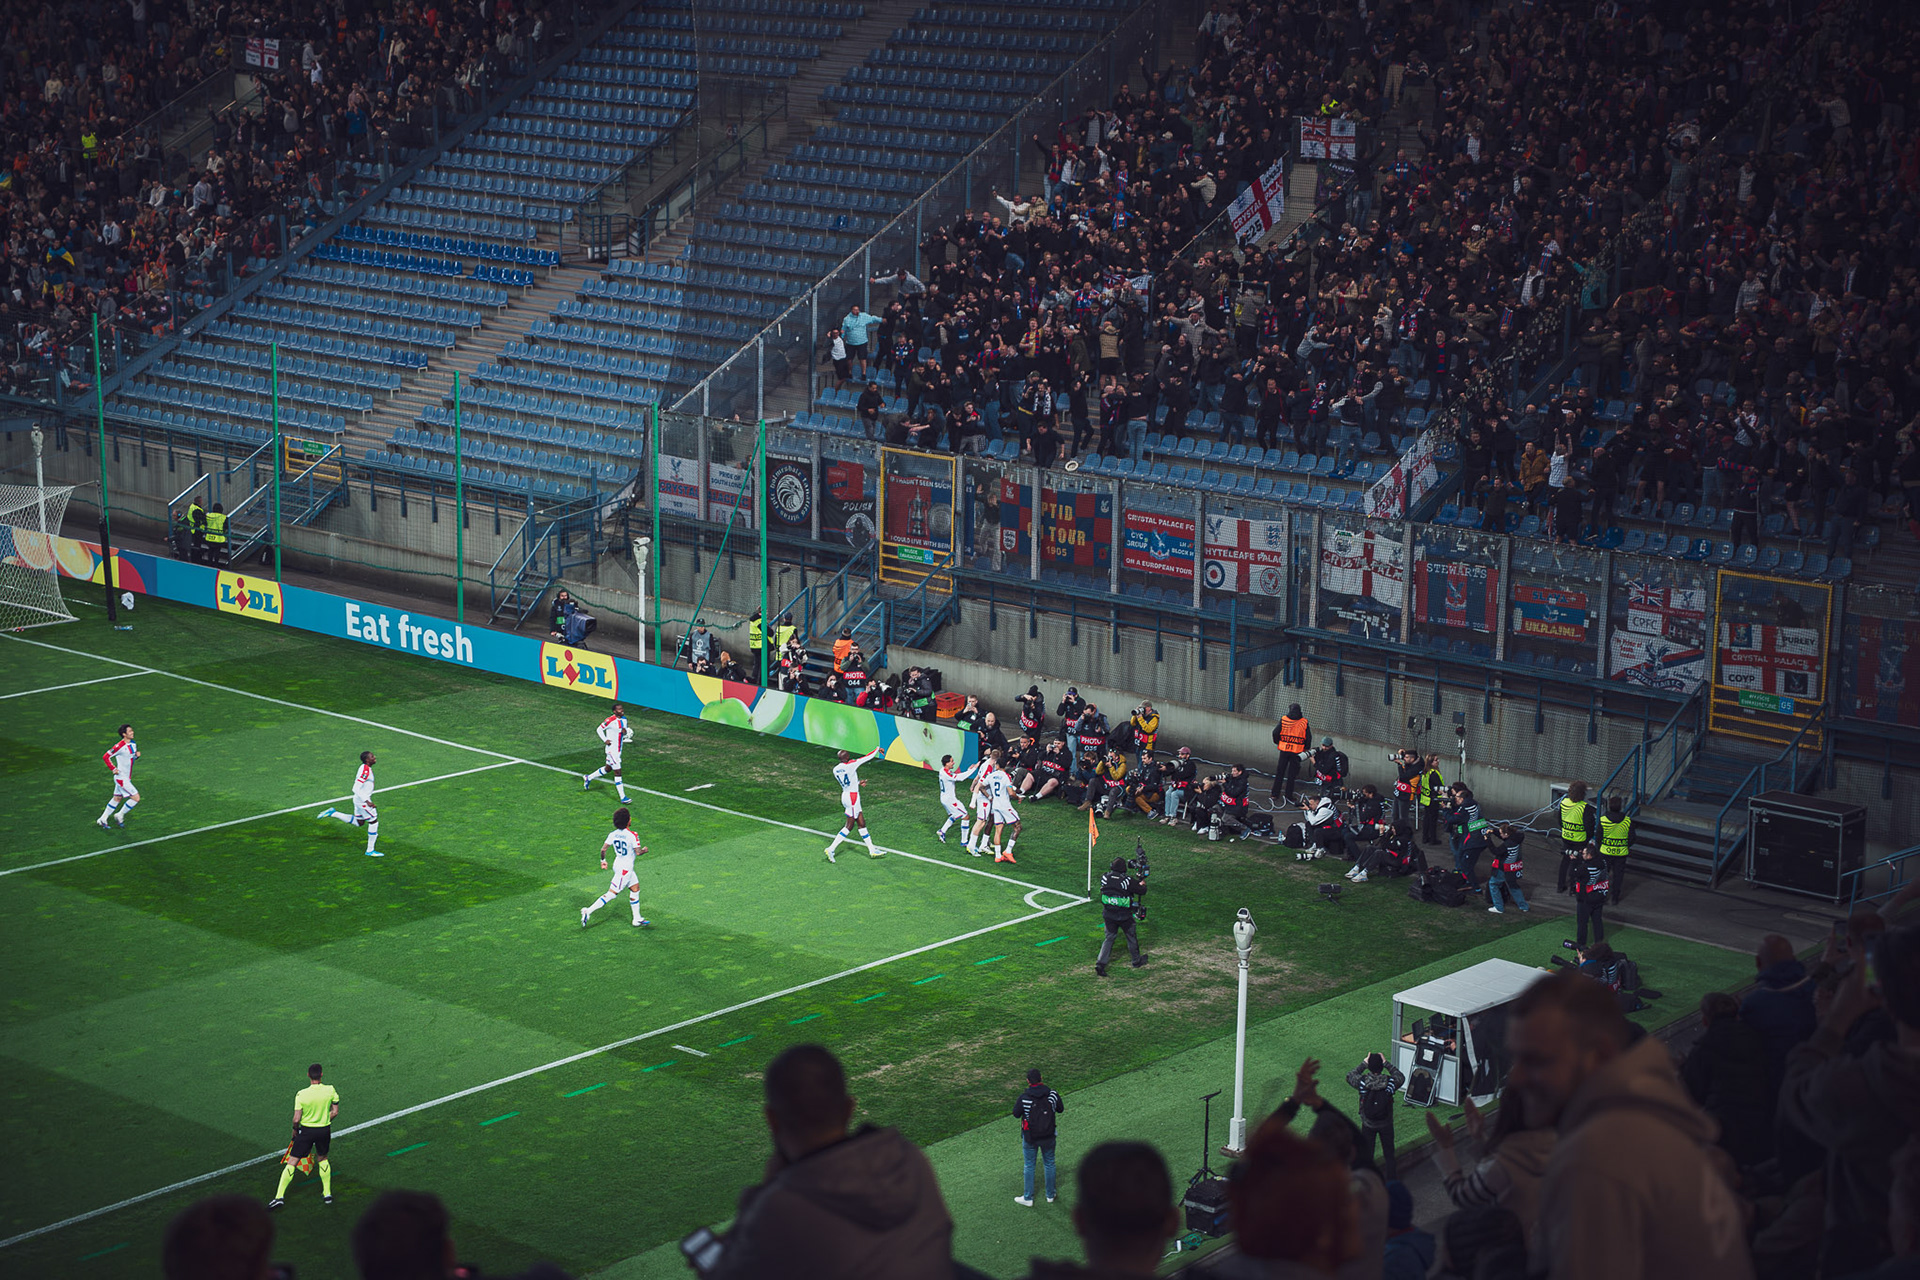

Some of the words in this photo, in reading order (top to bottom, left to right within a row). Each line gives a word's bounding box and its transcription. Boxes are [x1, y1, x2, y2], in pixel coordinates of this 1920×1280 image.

[1233, 200, 1263, 230] CRYSTAL
[919, 480, 933, 488] SEEN
[934, 482, 952, 490] SUCH
[1041, 502, 1073, 521] PTID
[1127, 513, 1158, 525] CRYSTAL
[1158, 518, 1184, 530] PALACE
[1185, 523, 1195, 531] FC
[893, 535, 910, 544] COULD
[911, 538, 922, 546] LIVE
[923, 539, 937, 548] WITH
[937, 542, 952, 550] BEIN
[1048, 526, 1086, 546] TOUR
[1130, 532, 1144, 540] CYC
[1046, 545, 1067, 557] 1905
[1126, 540, 1148, 549] GROUP
[1171, 547, 1189, 556] BLOCK
[1204, 547, 1255, 561] HYTELEAFE
[1257, 551, 1284, 564] PALAC
[1142, 560, 1175, 572] EUROPEAN
[1175, 566, 1193, 576] TOUR
[1426, 562, 1488, 579] STEWARTS
[1532, 591, 1569, 604] SLAVA
[1437, 617, 1470, 627] EUROPEAN
[1525, 620, 1575, 637] UKRAINI
[1633, 616, 1658, 630] CPFC
[346, 602, 391, 645] Eat
[398, 614, 473, 663] fresh
[1783, 635, 1816, 646] PURLEY
[1731, 653, 1768, 663] CRYSTAL
[1728, 674, 1755, 683] COYP
[1780, 700, 1792, 710] G5
[1081, 736, 1103, 745] PHOTO
[836, 773, 850, 787] 14
[994, 781, 1001, 797] 2
[613, 839, 628, 856] 26
